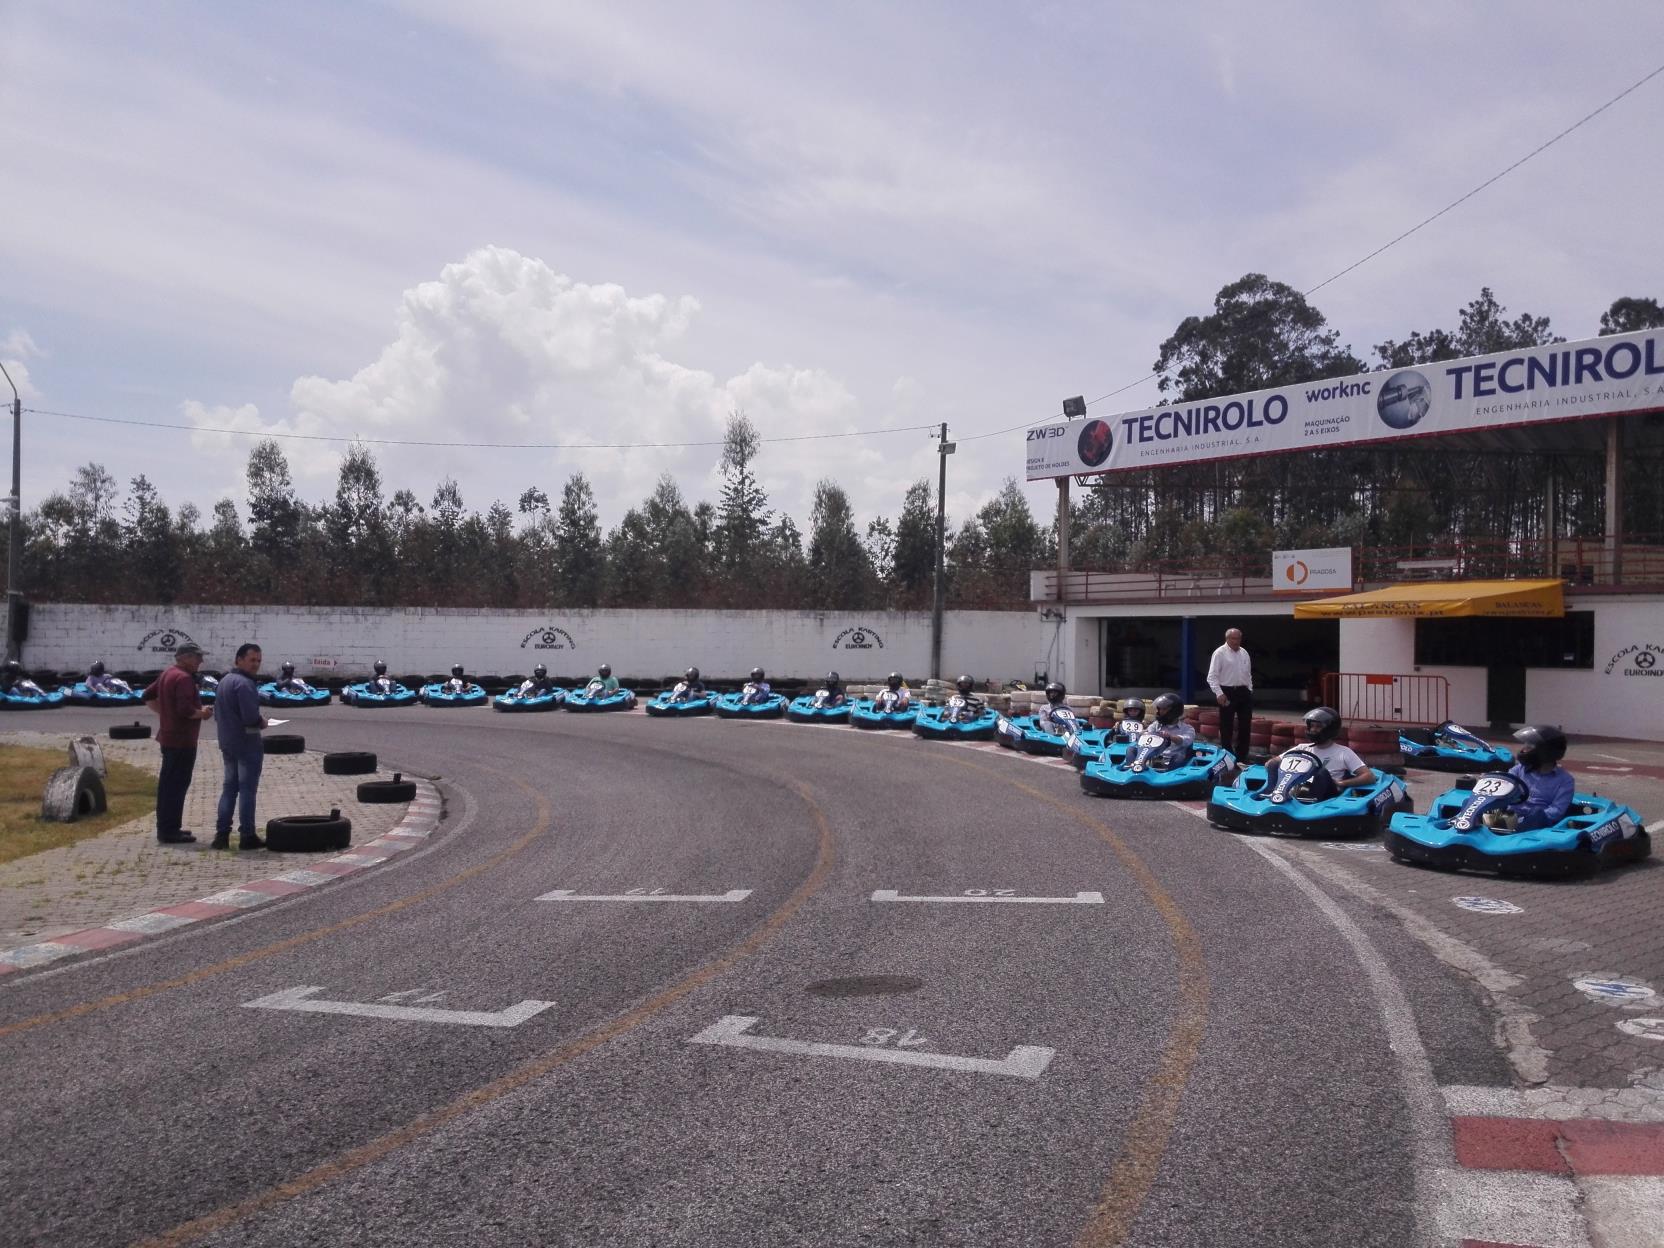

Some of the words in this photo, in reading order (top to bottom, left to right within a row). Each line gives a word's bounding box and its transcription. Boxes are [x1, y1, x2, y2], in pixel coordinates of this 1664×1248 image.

[1446, 338, 1664, 400] TECNIROL
[1305, 380, 1371, 403] worknc
[1476, 400, 1551, 415] ENGENHARIA
[1122, 394, 1288, 444] TECNIROLO
[1304, 415, 1350, 428] MAQUINAÇÃO
[1027, 426, 1066, 441] ZW3D
[1320, 426, 1340, 434] EIXOS
[1140, 445, 1188, 457] ENGENHARIA
[168, 628, 193, 643] KARTI
[520, 627, 545, 648] ESCOLA
[549, 626, 576, 650] KARTING
[832, 627, 855, 649] ESCOLA
[858, 627, 884, 649] KARTING
[1604, 644, 1639, 675] ESCOLA
[1126, 722, 1139, 731] 29
[1145, 737, 1153, 746] 9
[1287, 759, 1302, 771] 17
[1479, 780, 1502, 793] 23
